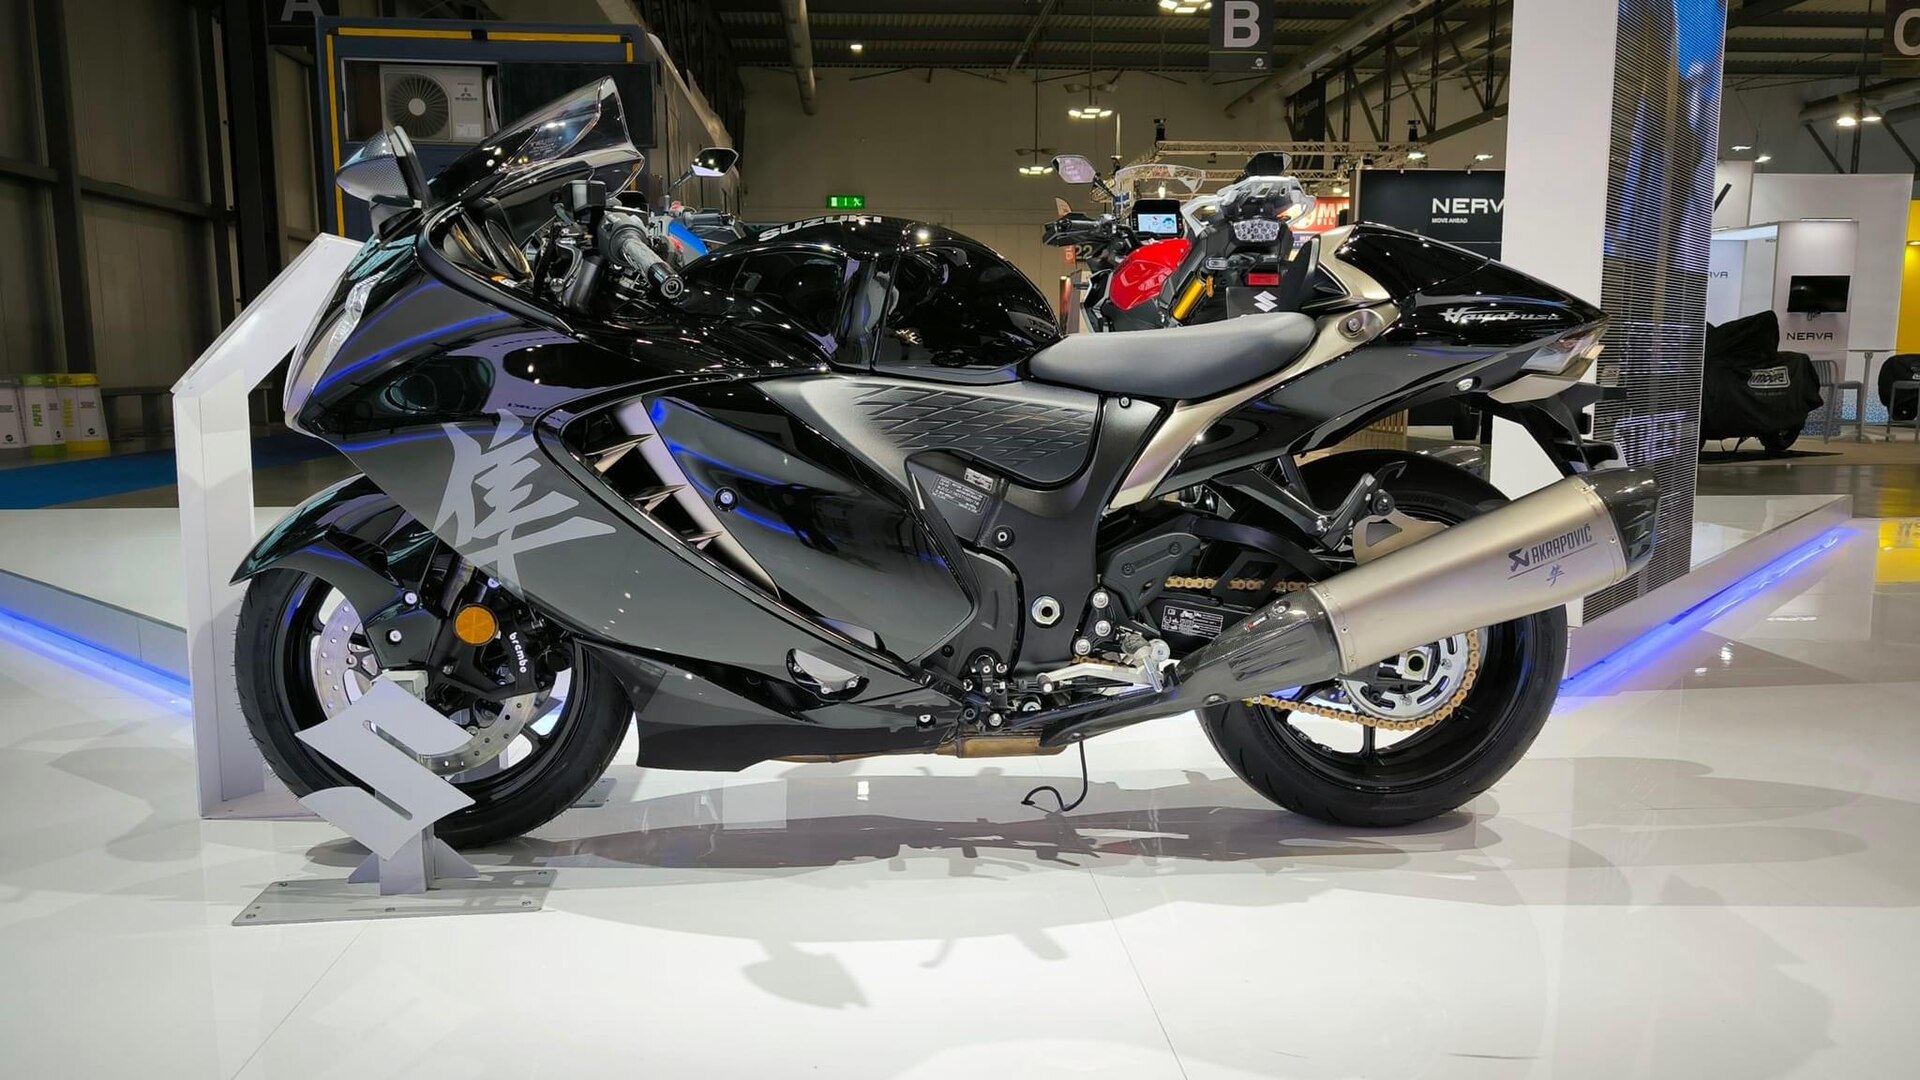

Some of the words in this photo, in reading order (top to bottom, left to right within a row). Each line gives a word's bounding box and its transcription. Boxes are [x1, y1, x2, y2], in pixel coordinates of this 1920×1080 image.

[1224, 0, 1260, 48] B
[758, 214, 882, 242] SUZUKI
[1438, 306, 1564, 324] Hayabusa
[1786, 332, 1833, 341] NERVA
[32, 403, 43, 428] PAPER
[509, 631, 527, 674] brembo
